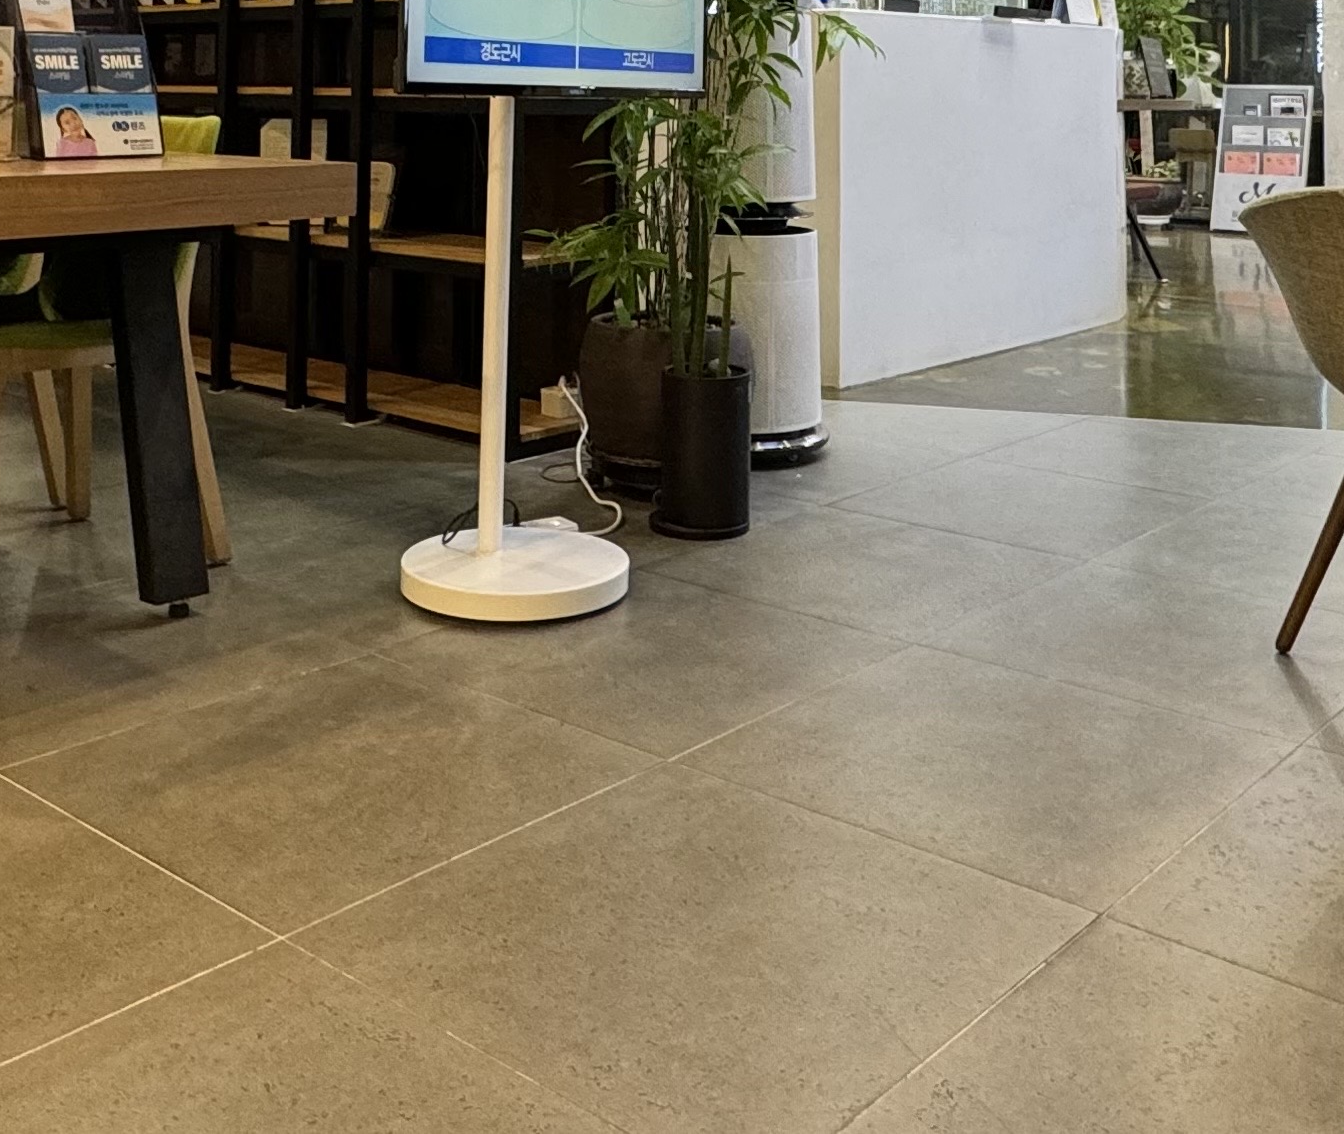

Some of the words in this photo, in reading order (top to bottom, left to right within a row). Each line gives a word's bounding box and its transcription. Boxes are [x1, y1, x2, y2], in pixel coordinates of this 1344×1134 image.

[480, 42, 521, 63] 경도근시
[622, 52, 655, 70] 고도근시
[34, 54, 80, 70] SMILE
[100, 54, 144, 70] SMILE
